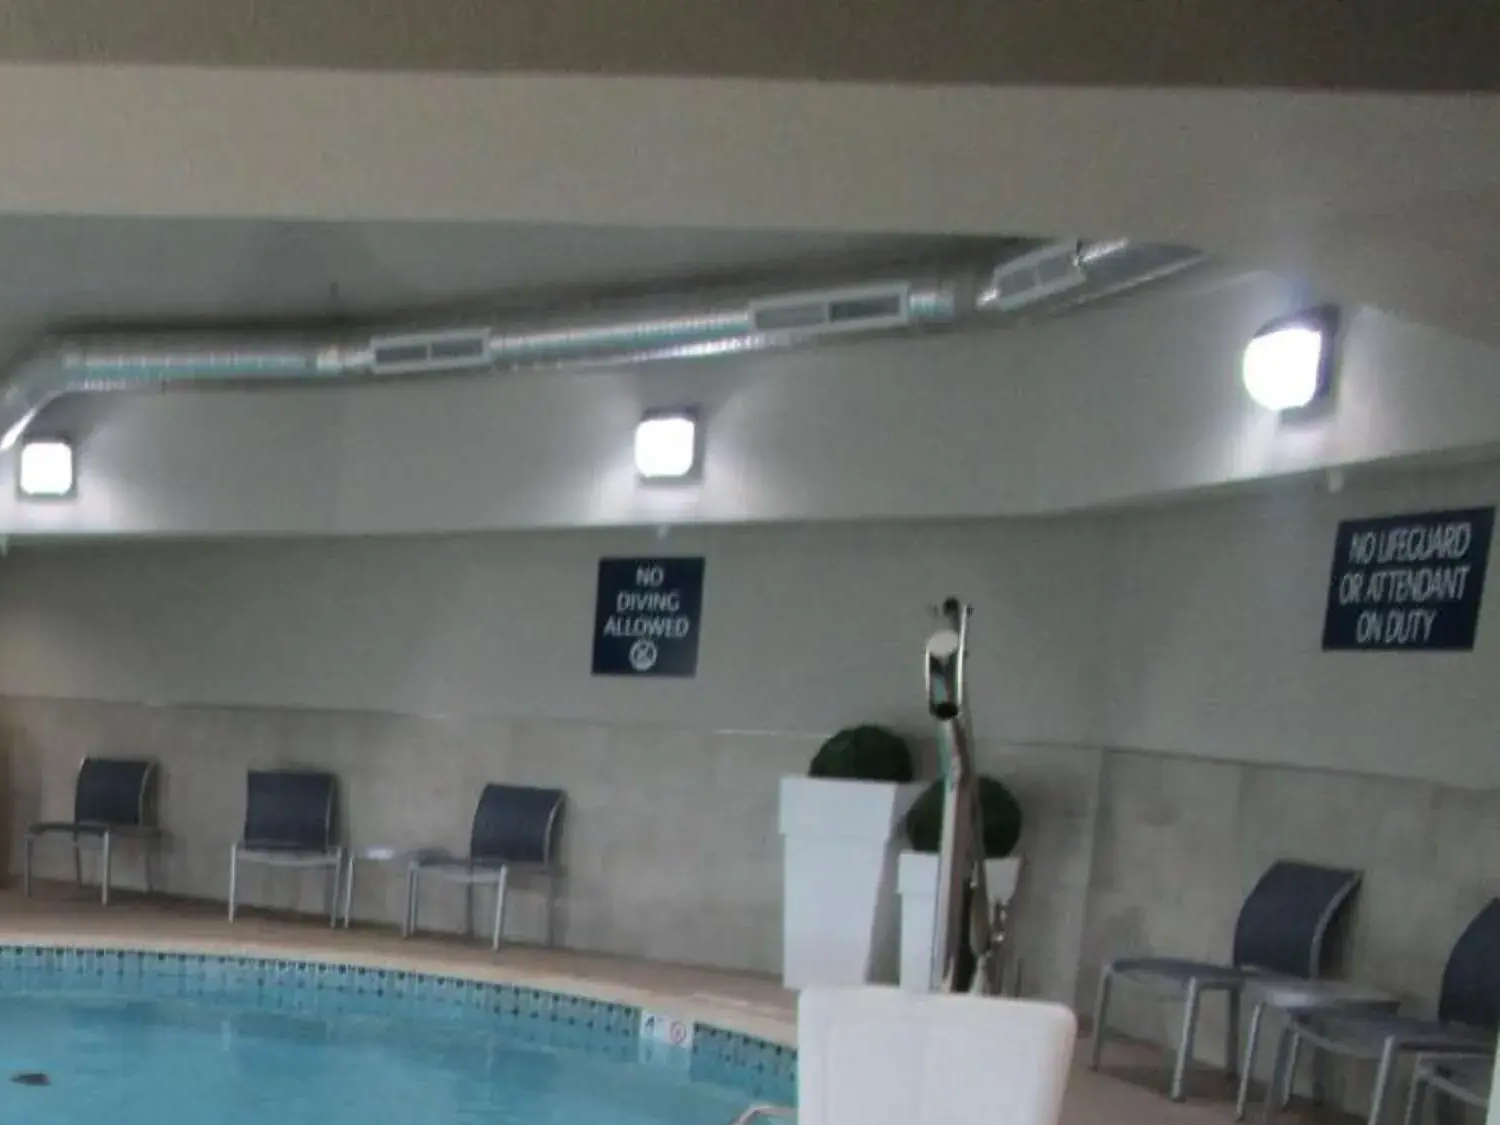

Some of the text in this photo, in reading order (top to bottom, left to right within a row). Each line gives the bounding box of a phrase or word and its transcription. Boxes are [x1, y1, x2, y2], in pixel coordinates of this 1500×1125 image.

[1349, 521, 1473, 565] NO LIFEGUARD
[635, 566, 665, 588] NO
[1338, 565, 1471, 606] OR ATTENDANT
[616, 591, 681, 613] DIVING
[603, 615, 690, 638] ALLOWED
[1356, 607, 1438, 645] ON DUTY
